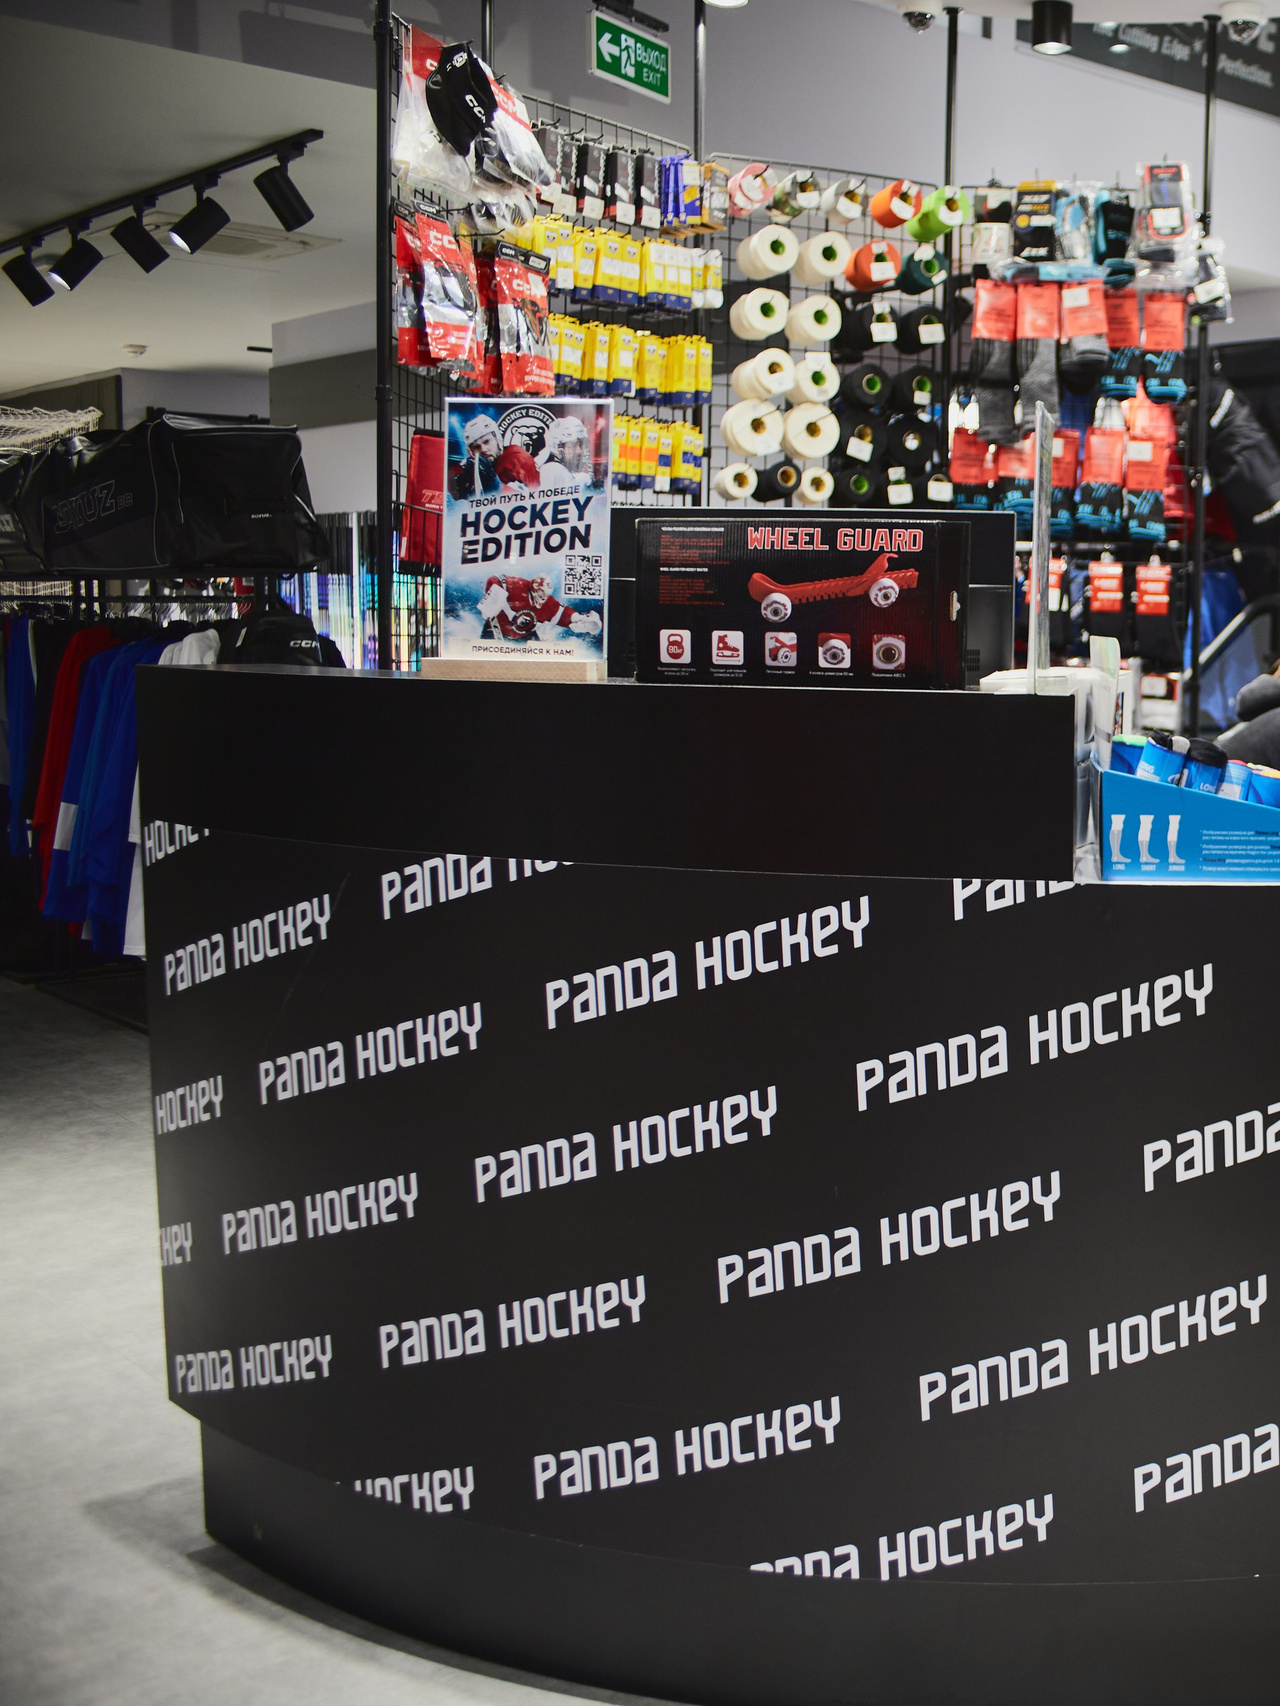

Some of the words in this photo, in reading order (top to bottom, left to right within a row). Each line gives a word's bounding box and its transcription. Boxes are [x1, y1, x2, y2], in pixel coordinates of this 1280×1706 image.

[636, 42, 666, 74] ВЫХОД
[643, 68, 662, 87] EXIT
[429, 230, 458, 250] CC
[470, 494, 498, 509] ТВОЙ
[500, 492, 527, 505] ПУТЬ
[529, 491, 536, 501] К
[538, 484, 581, 499] ПОБЕДЕ
[460, 496, 594, 538] HOCKEY
[461, 524, 592, 565] EDITION
[747, 526, 829, 550] WHEEL
[837, 528, 923, 552] GUARD
[472, 645, 544, 655] ПРИСОЕДИНЯЙСЯ
